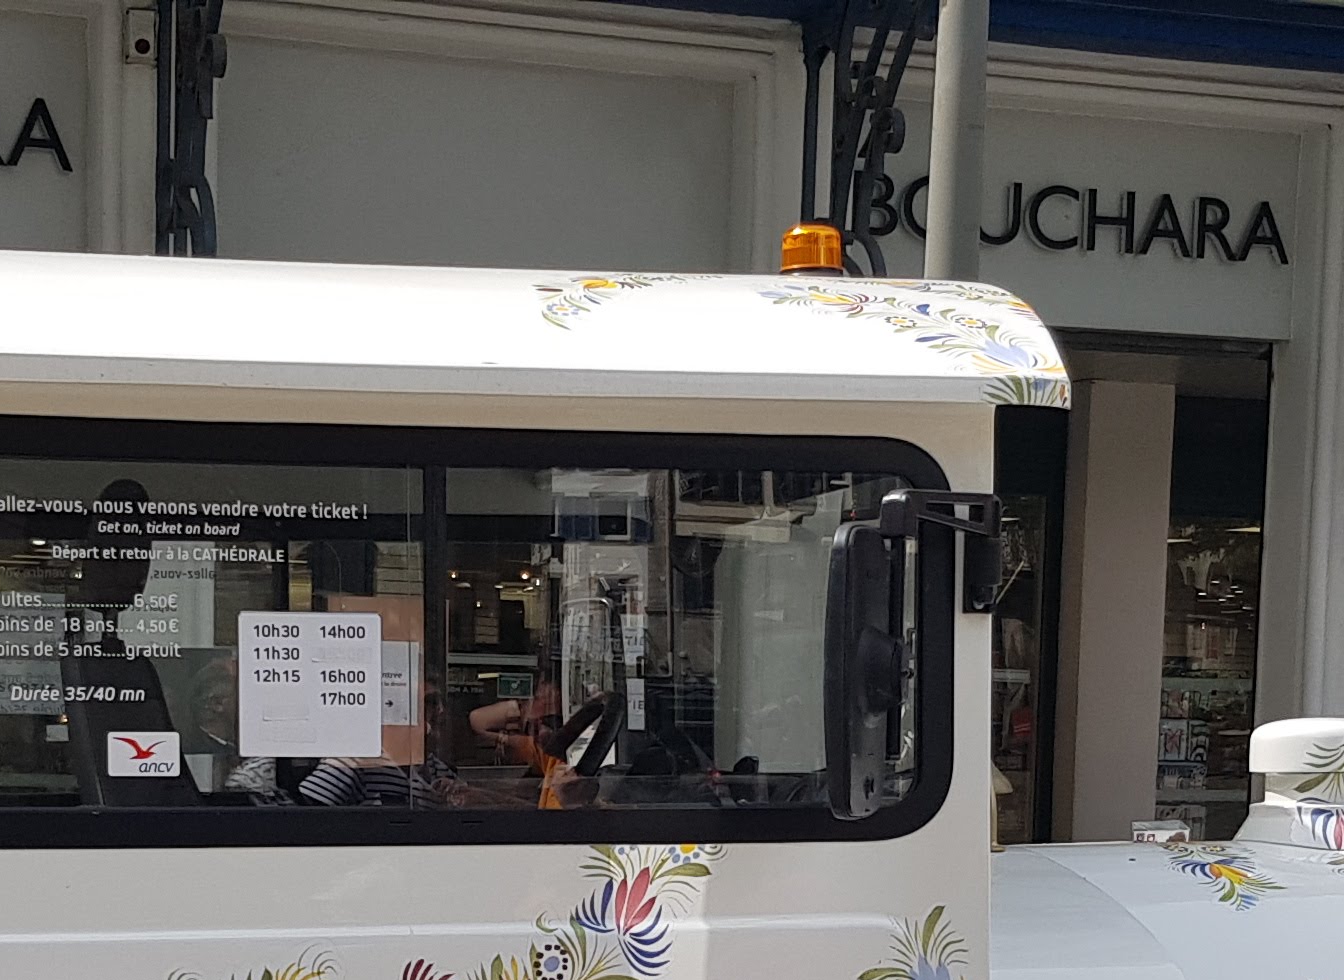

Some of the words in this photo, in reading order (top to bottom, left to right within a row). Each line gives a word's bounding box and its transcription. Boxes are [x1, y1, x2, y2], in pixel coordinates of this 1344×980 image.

[93, 500, 133, 515] nous
[138, 502, 198, 516] venons
[202, 500, 258, 518] vendre
[263, 504, 307, 519] votre
[311, 501, 359, 520] ticket
[97, 520, 120, 535] Get
[123, 523, 143, 536] on,
[146, 520, 182, 536] ticket
[185, 524, 201, 535] on
[204, 521, 241, 537] board
[52, 544, 99, 564] Départ
[103, 547, 117, 560] et
[120, 547, 162, 562] retour
[165, 546, 174, 561] à
[177, 545, 190, 562] la
[192, 544, 286, 564] CATHÉDRALE
[34, 615, 54, 633] de
[60, 617, 81, 632] 18
[253, 624, 300, 638] 10h30
[319, 625, 366, 639] 14h00
[34, 641, 54, 658] de
[58, 642, 69, 658] 5
[253, 647, 300, 661] 11h30
[253, 669, 301, 683] 12h15
[319, 669, 366, 684] 16h00
[10, 685, 61, 702] Durée
[64, 686, 116, 702] 35/40
[119, 689, 146, 702] mn
[320, 692, 366, 706] 17h00
[139, 761, 175, 773] ancv
